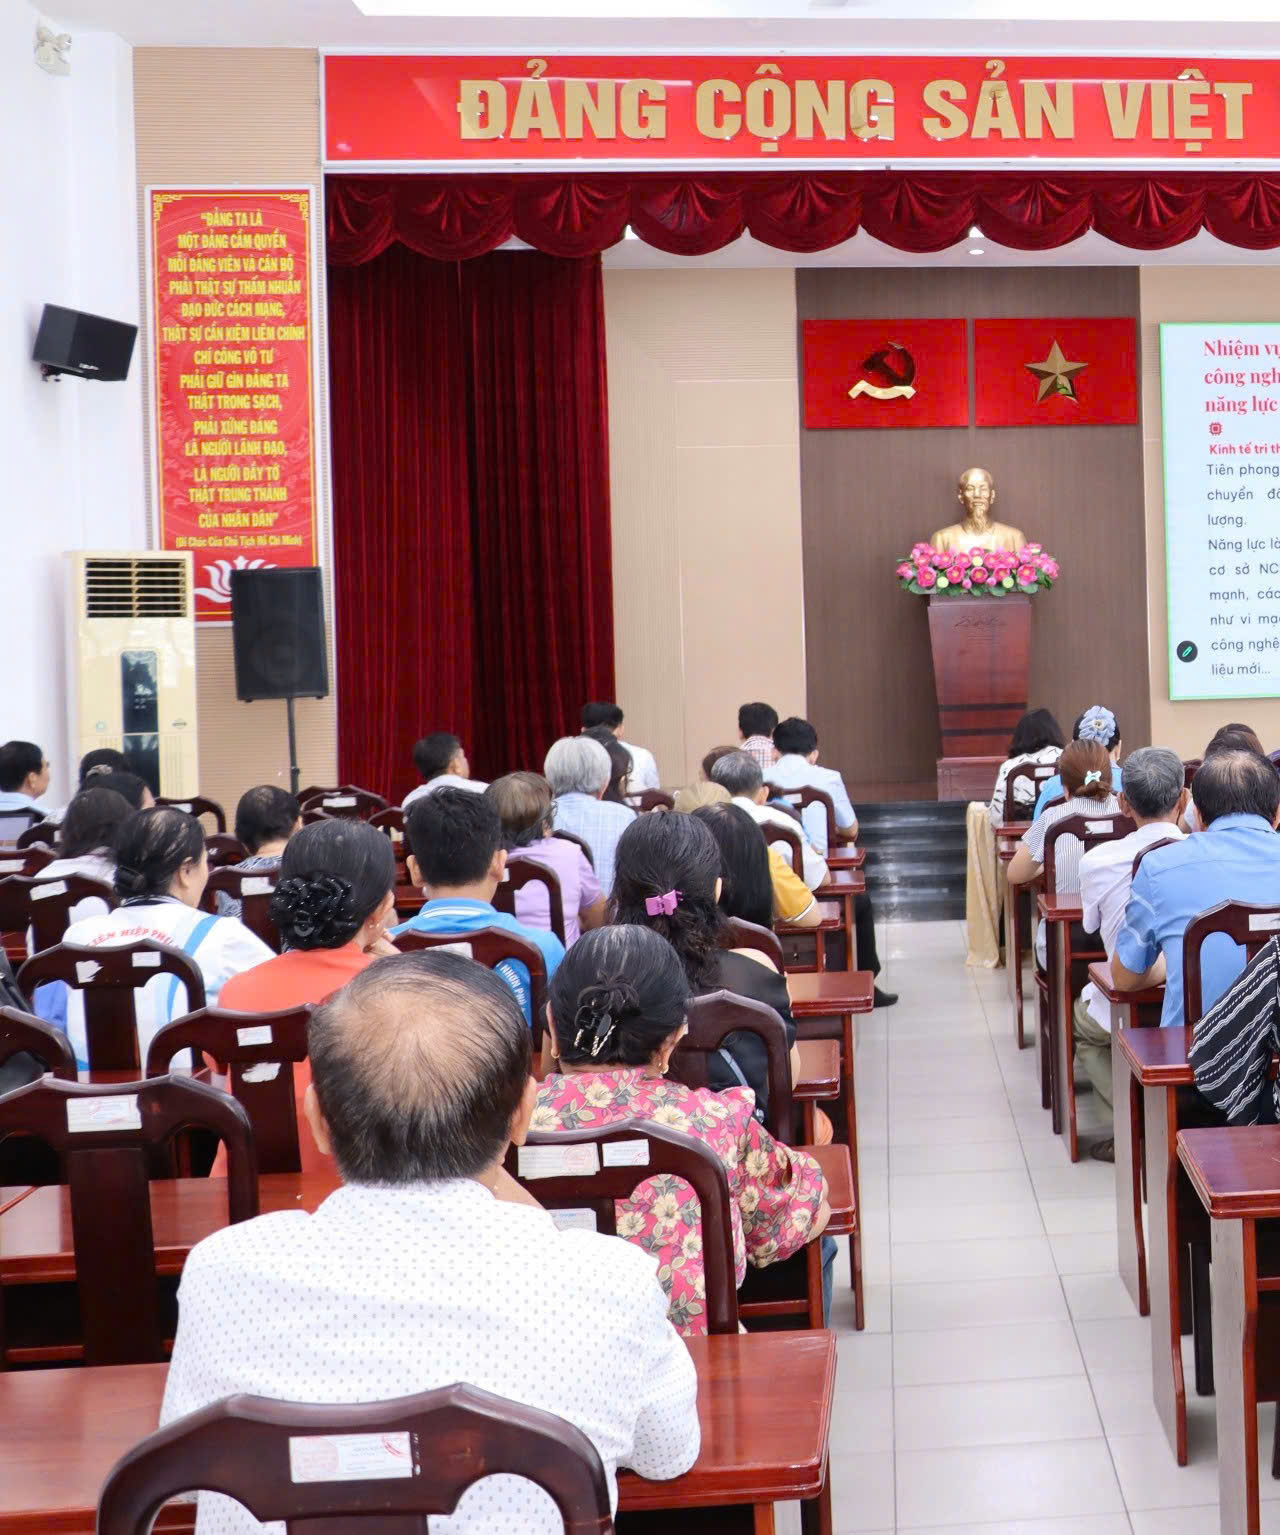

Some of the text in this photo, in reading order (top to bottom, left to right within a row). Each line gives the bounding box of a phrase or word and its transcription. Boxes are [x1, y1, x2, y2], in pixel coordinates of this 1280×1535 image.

[457, 59, 668, 139] ĐẢNG
[696, 64, 894, 152] CỘNG
[923, 59, 1076, 141] SẢN
[1101, 69, 1253, 151] VIỆT
[1204, 338, 1259, 359] Nhiệm
[1204, 368, 1245, 387] công
[1205, 395, 1247, 415] năng
[1252, 395, 1278, 415] lực
[1209, 443, 1236, 454] Kinh
[1238, 441, 1251, 454] tế
[1254, 443, 1268, 454] tri
[1206, 463, 1233, 475] Tiên
[1239, 463, 1279, 477] phong
[1207, 485, 1253, 502] chuyển
[1208, 538, 1242, 552] Năng
[1247, 538, 1265, 552] lực
[1209, 565, 1225, 575] cơ
[1235, 562, 1249, 575] sở
